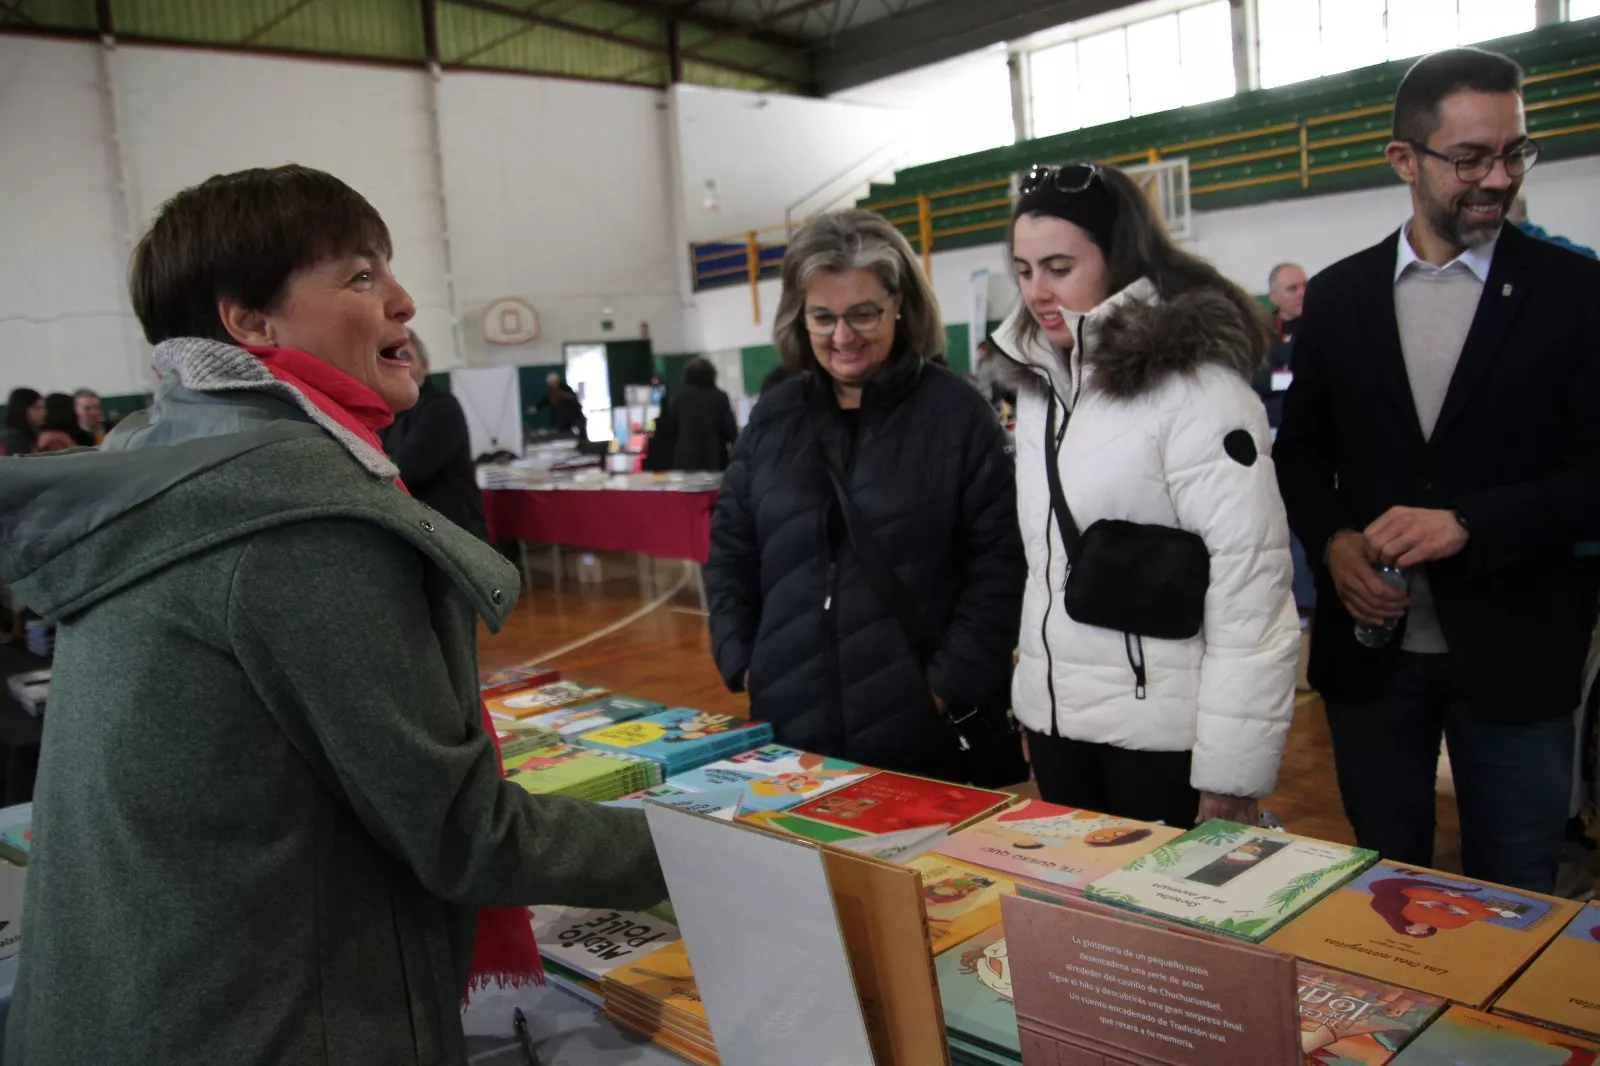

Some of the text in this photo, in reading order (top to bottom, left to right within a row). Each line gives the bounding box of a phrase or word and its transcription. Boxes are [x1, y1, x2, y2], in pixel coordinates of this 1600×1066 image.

[1011, 854, 1057, 870] QUIERO
[1151, 883, 1196, 898] ascensor
[1197, 893, 1211, 902] el
[557, 929, 632, 960] MEDIO
[1072, 935, 1082, 944] La
[1082, 938, 1123, 956] glotonería
[1124, 949, 1134, 958] de
[1147, 955, 1184, 971] pequeño
[1185, 965, 1209, 977] ratón
[1079, 953, 1204, 991] desencadena una serie de actos
[1393, 956, 1422, 969] tres
[1424, 963, 1449, 976] Las
[1048, 971, 1069, 985] Sigue
[1070, 978, 1078, 986] el
[1079, 980, 1094, 991] hilo
[1101, 987, 1147, 1006] descubrirás
[1148, 1001, 1163, 1011] una
[1164, 1004, 1184, 1017] gran
[1185, 1009, 1221, 1027] sorpresa
[1222, 1019, 1245, 1033] final.
[1066, 964, 1221, 1012] alrededor del castillo de Chuchurumbel.
[1298, 986, 1372, 1021] LOA
[1069, 992, 1226, 1044] Un cuento encadenado de Tradición oral
[1299, 1005, 1323, 1019] CA
[1100, 1016, 1114, 1027] que
[1115, 1019, 1139, 1033] retará
[1146, 1029, 1155, 1038] tu
[1156, 1032, 1195, 1050] memoria.
